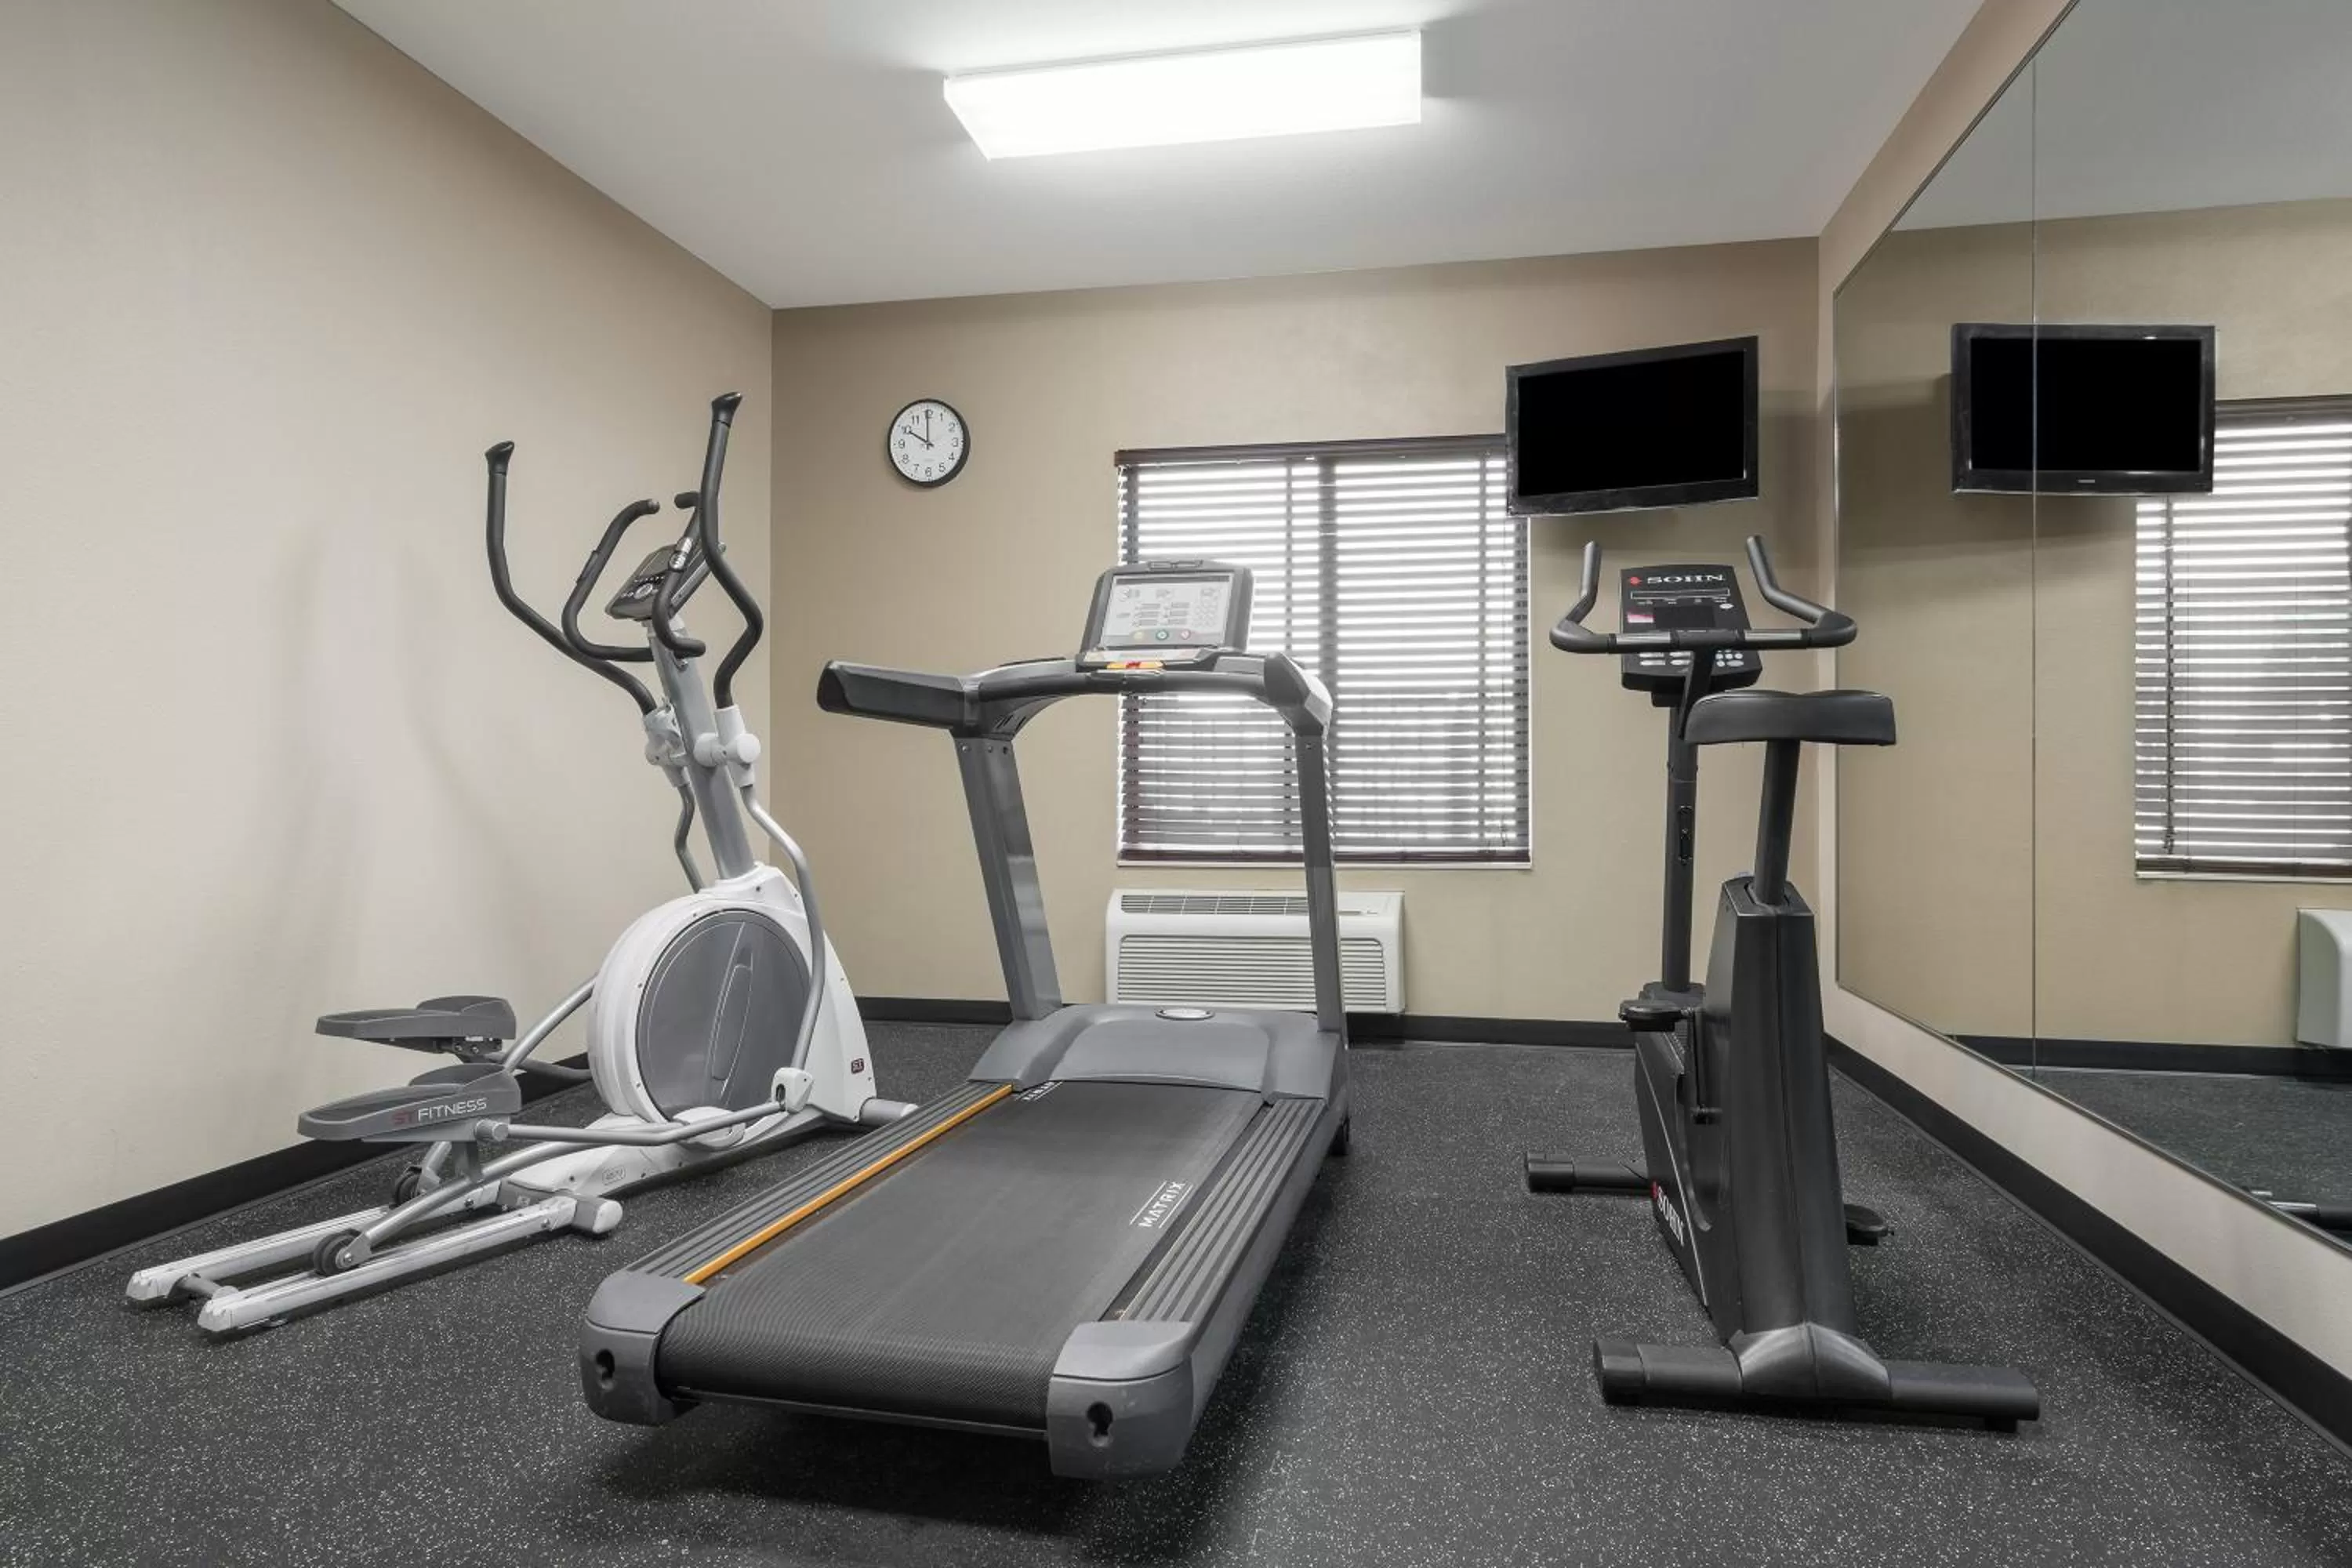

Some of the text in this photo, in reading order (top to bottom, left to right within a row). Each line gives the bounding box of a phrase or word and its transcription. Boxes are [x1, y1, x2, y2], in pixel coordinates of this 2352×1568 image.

[911, 415, 920, 425] 11
[948, 422, 956, 433] 2
[898, 438, 906, 449] 9
[951, 437, 959, 448] 3
[902, 454, 909, 465] 8
[948, 452, 955, 461] 4
[913, 463, 920, 473] 7
[924, 466, 932, 477] 6
[938, 462, 946, 473] 5
[418, 1097, 488, 1123] FITNESS
[1138, 1181, 1186, 1228] MATRIX
